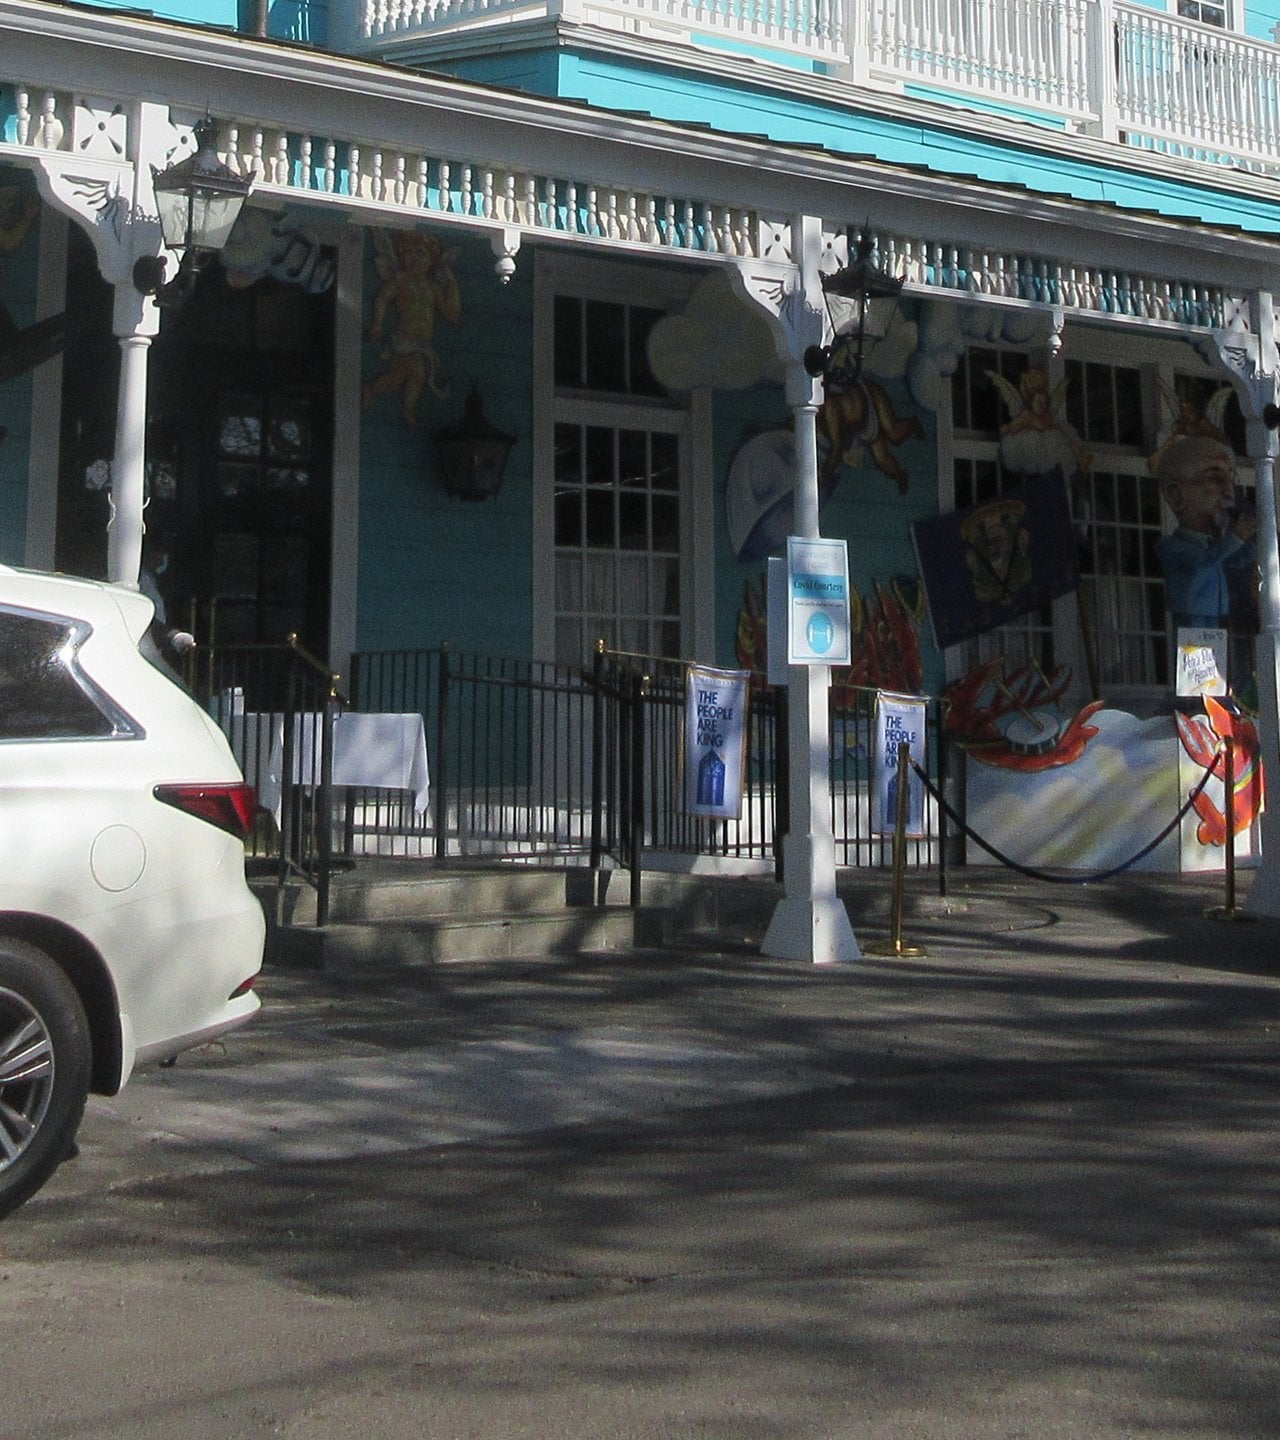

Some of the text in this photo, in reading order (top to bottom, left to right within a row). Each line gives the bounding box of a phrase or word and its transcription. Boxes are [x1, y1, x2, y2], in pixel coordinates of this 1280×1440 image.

[698, 690, 718, 705] THE
[697, 705, 733, 721] PEOPLE
[697, 719, 717, 733] ARE
[885, 715, 903, 729] THE
[697, 732, 724, 747] KING
[885, 729, 916, 743] PEOPLE
[885, 741, 897, 754] AR
